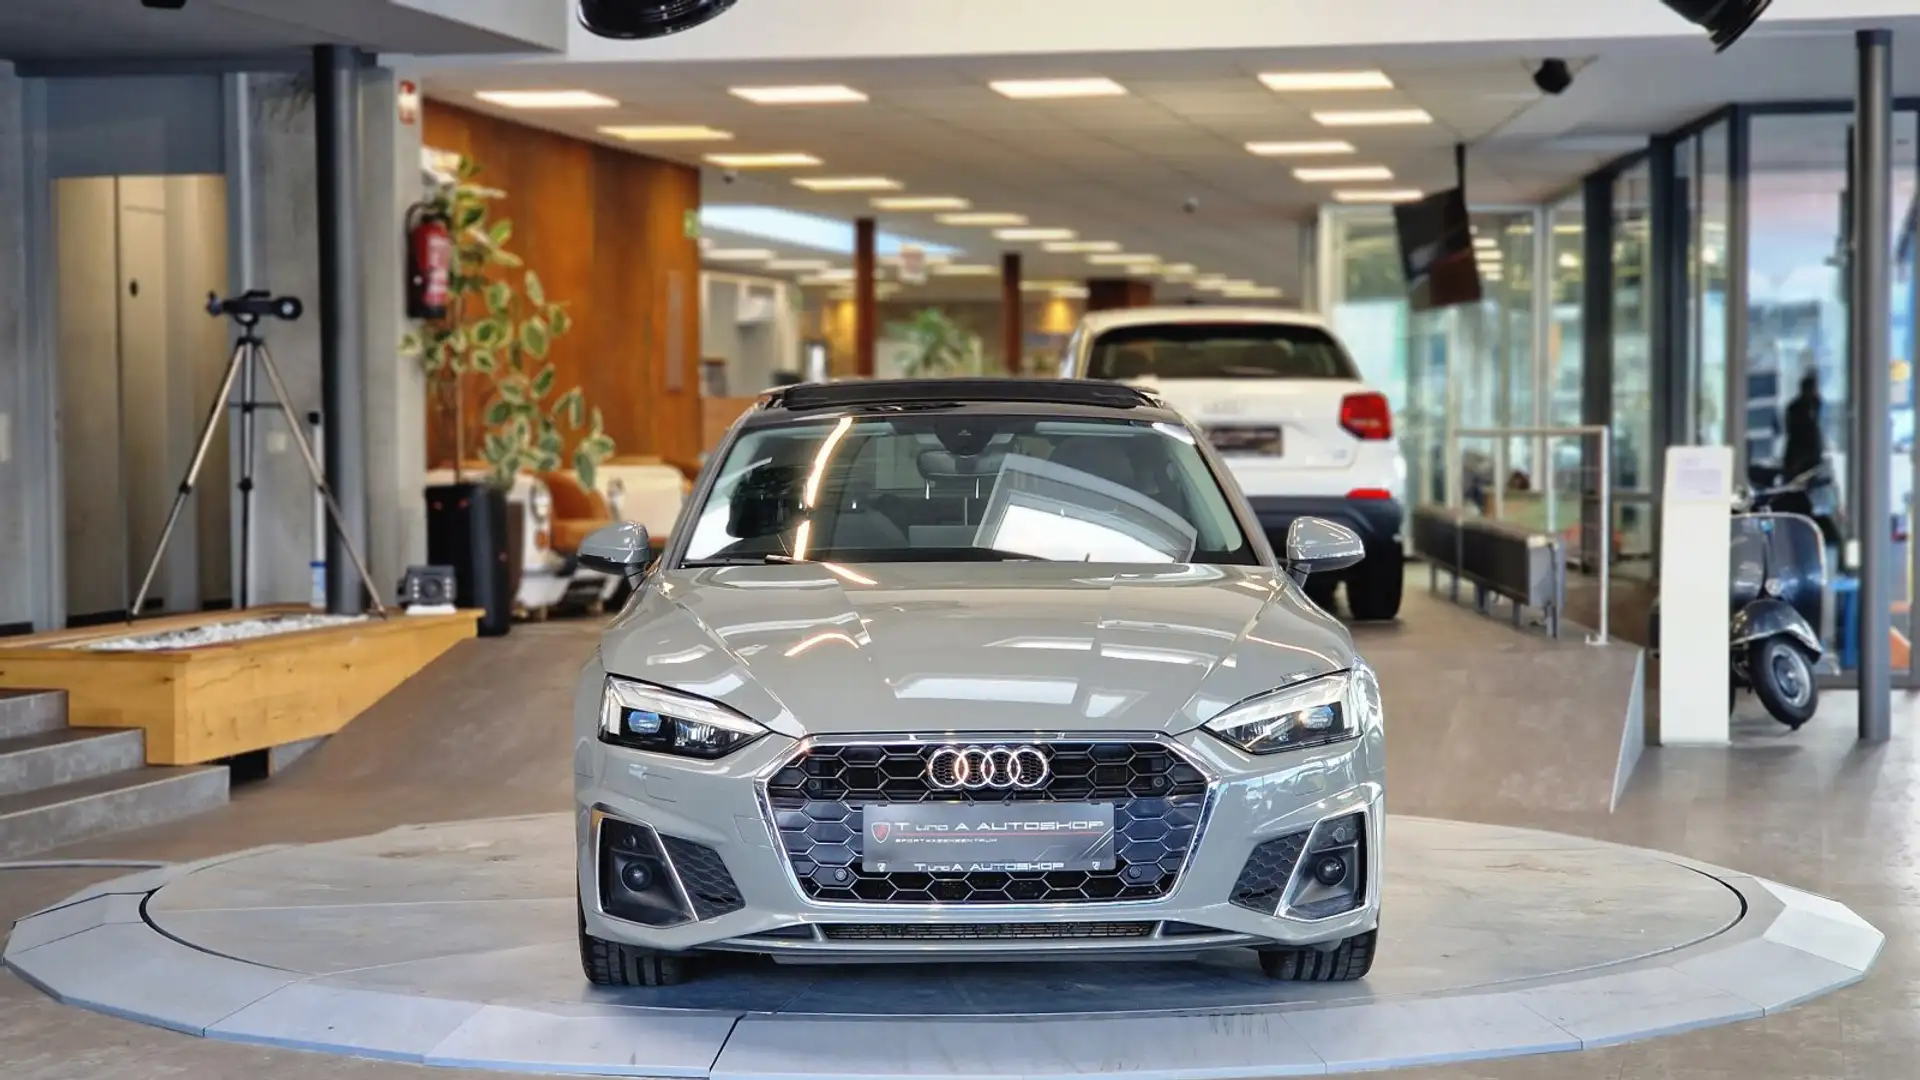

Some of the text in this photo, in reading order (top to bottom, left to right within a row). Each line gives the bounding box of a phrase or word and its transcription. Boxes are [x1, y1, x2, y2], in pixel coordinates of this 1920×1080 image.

[894, 821, 911, 832] T
[954, 821, 970, 832] A
[976, 820, 1105, 831] AUTOSHOP
[914, 862, 927, 872] T
[951, 863, 964, 872] A
[970, 862, 1065, 872] AUTOSHOP
